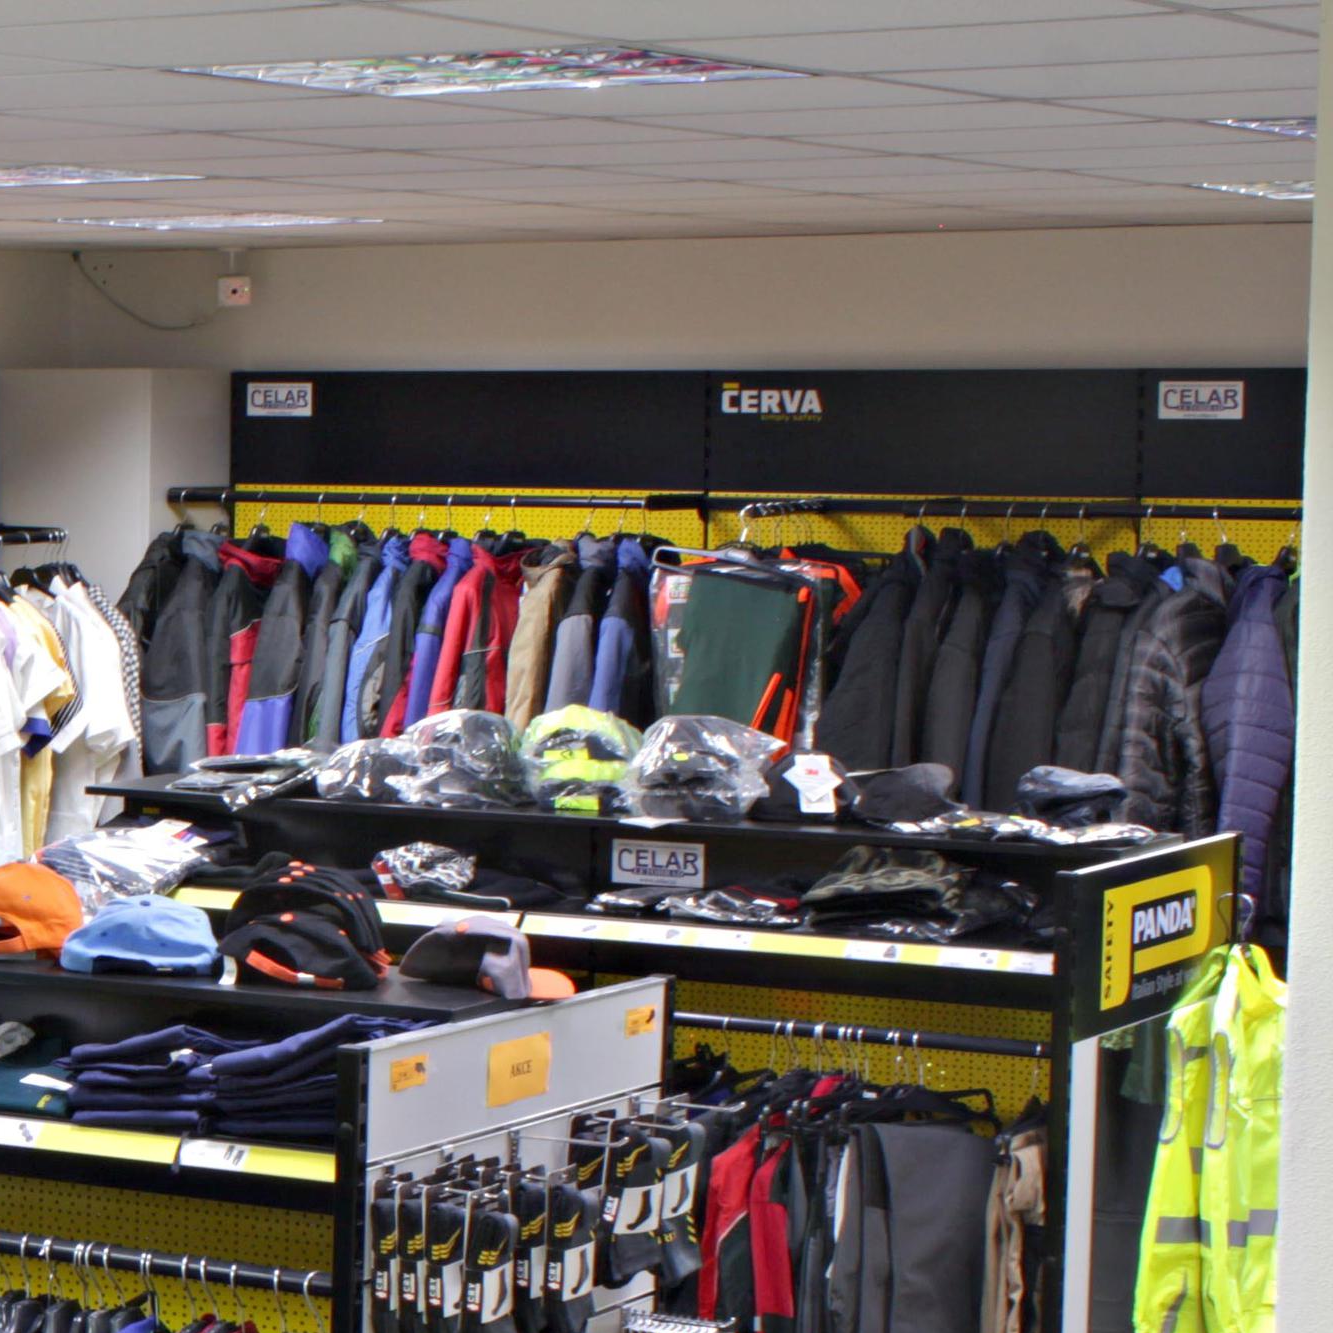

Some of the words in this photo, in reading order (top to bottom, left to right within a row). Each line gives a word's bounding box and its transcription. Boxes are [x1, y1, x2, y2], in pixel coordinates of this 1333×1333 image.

[251, 389, 309, 408] CELAR
[1163, 388, 1239, 409] CELAR
[617, 848, 700, 876] CELAR
[1133, 897, 1195, 944] PANDA
[1104, 900, 1115, 999] SAFETY
[510, 1060, 533, 1078] AKCE
